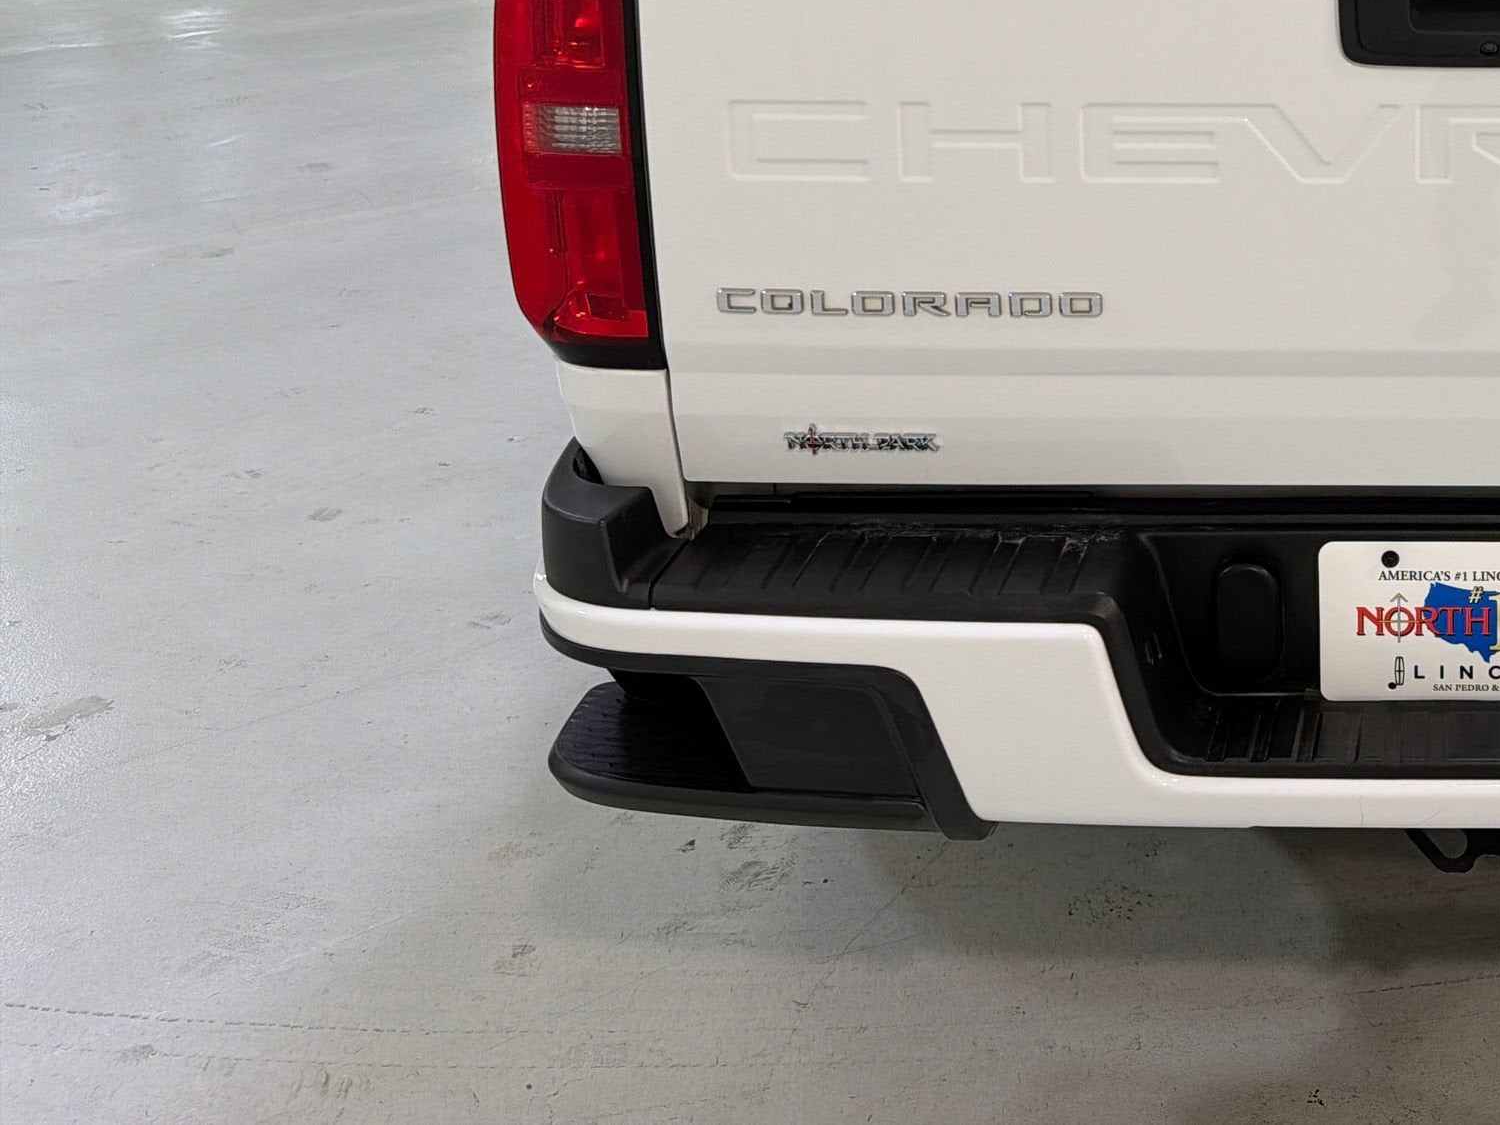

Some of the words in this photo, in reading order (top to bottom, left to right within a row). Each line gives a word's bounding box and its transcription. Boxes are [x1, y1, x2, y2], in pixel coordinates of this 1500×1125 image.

[716, 286, 1103, 317] COLORADO
[784, 431, 870, 452] NORTH
[873, 432, 943, 452] PARK
[1378, 570, 1451, 582] AMERICA'S
[1454, 571, 1468, 582] #1
[1356, 606, 1491, 637] NORTH
[1432, 683, 1453, 692] SAN
[1455, 683, 1490, 692] PEDRO
[1491, 683, 1500, 692] &
